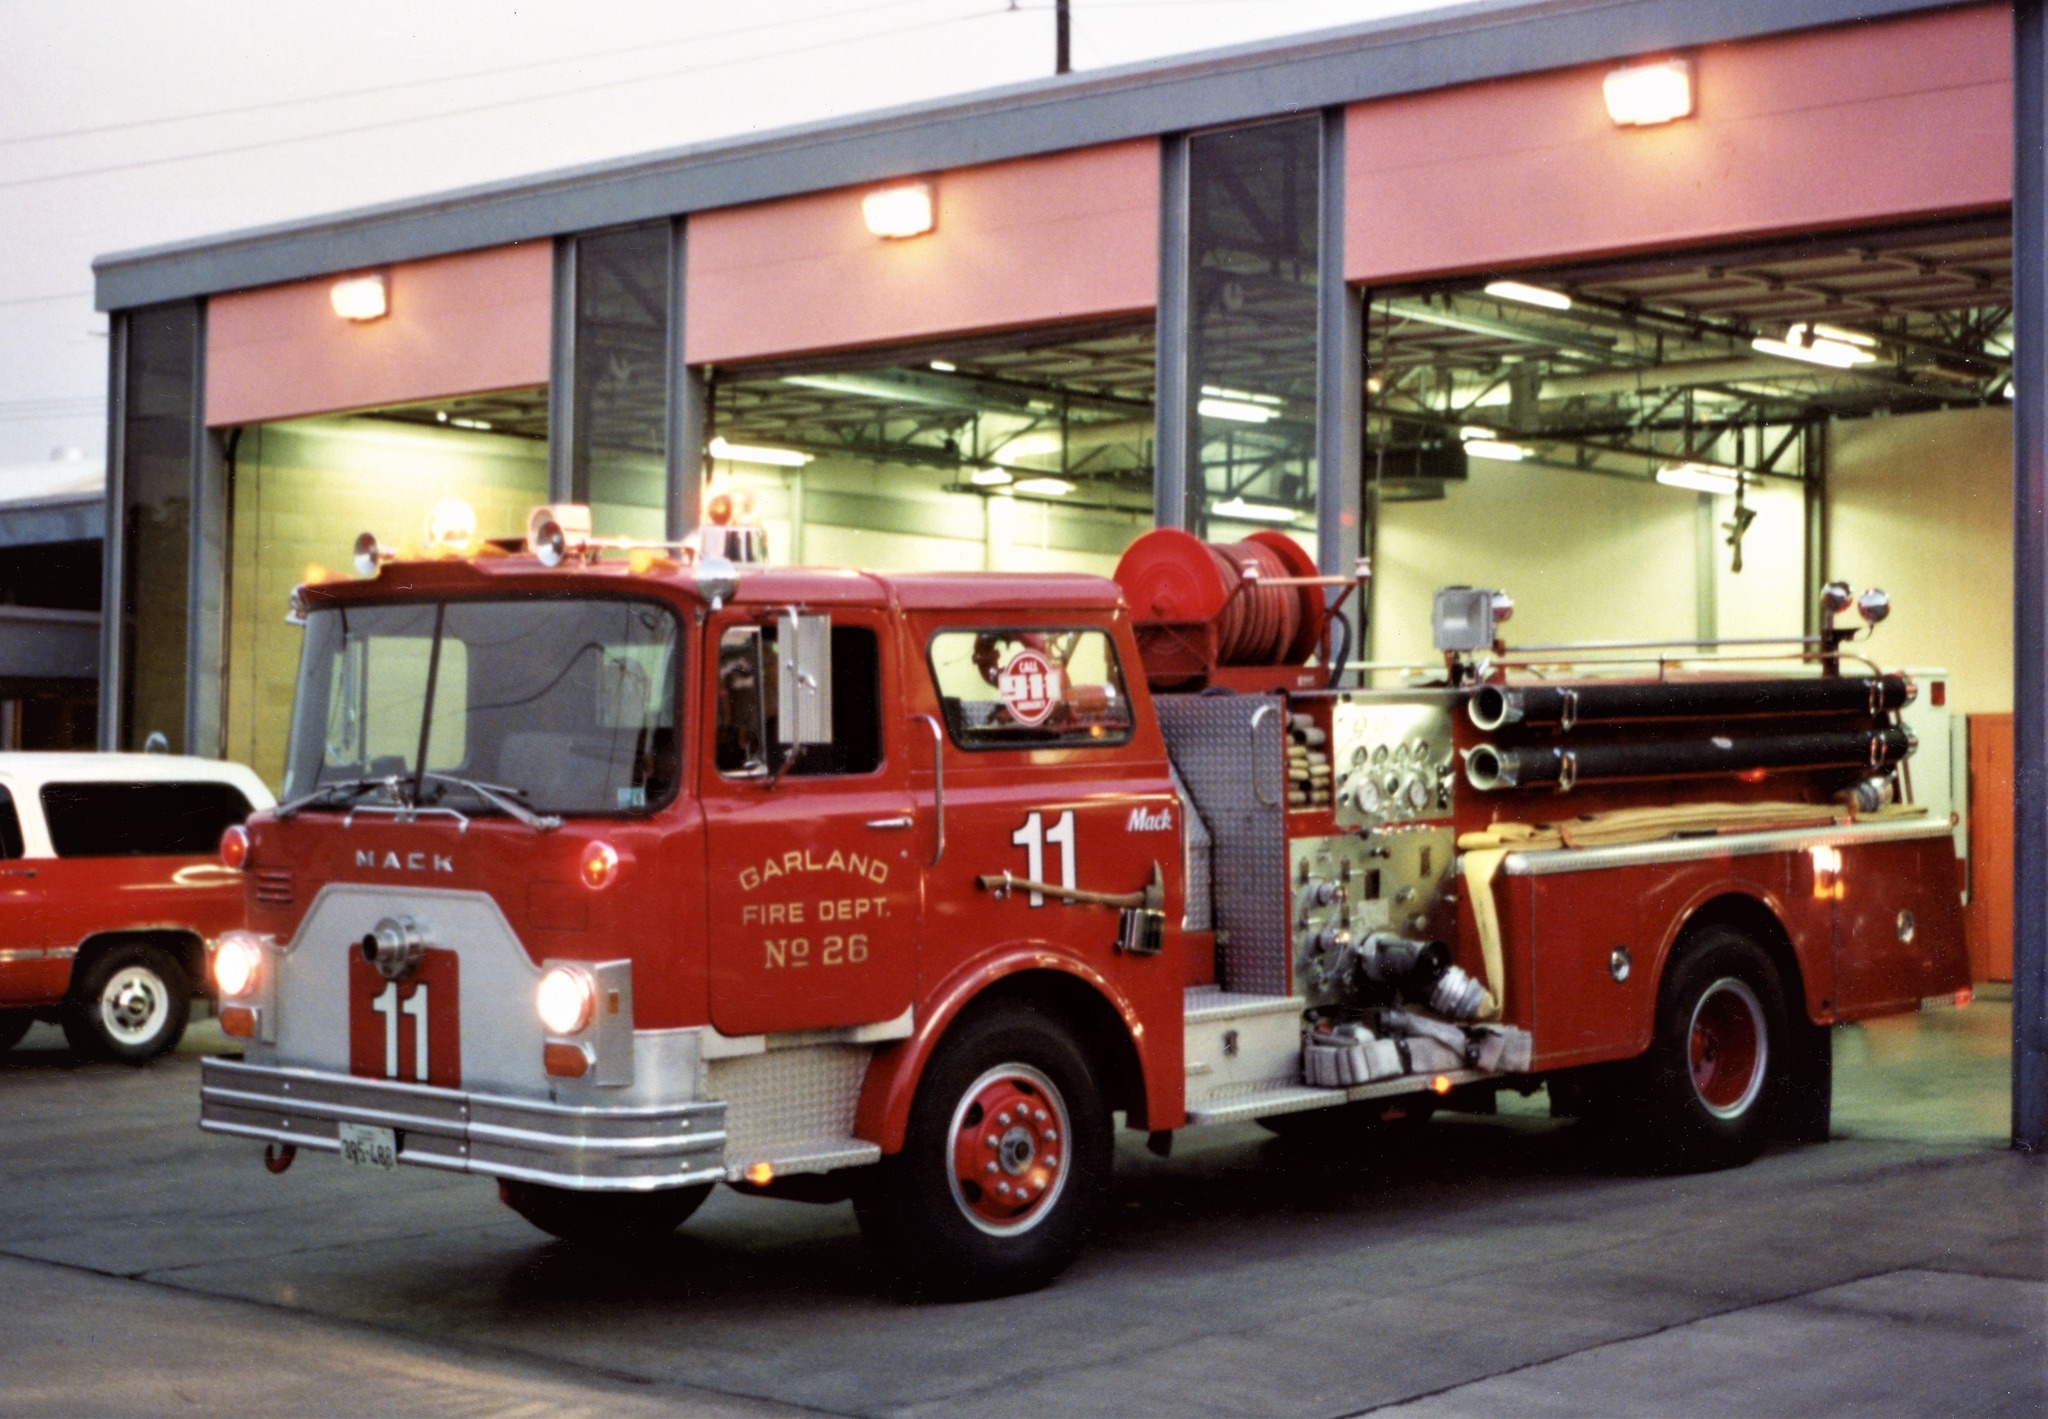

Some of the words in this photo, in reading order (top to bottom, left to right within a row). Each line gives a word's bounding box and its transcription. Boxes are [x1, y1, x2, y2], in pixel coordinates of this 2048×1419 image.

[999, 670, 1062, 702] 911
[1126, 807, 1174, 832] Mack
[356, 849, 454, 872] MACK
[739, 849, 889, 891] GARLAND
[1012, 810, 1077, 907] 11
[742, 904, 805, 927] FIRE
[818, 897, 891, 922] DEPT.
[822, 934, 869, 966] 26
[373, 981, 430, 1082] 11
